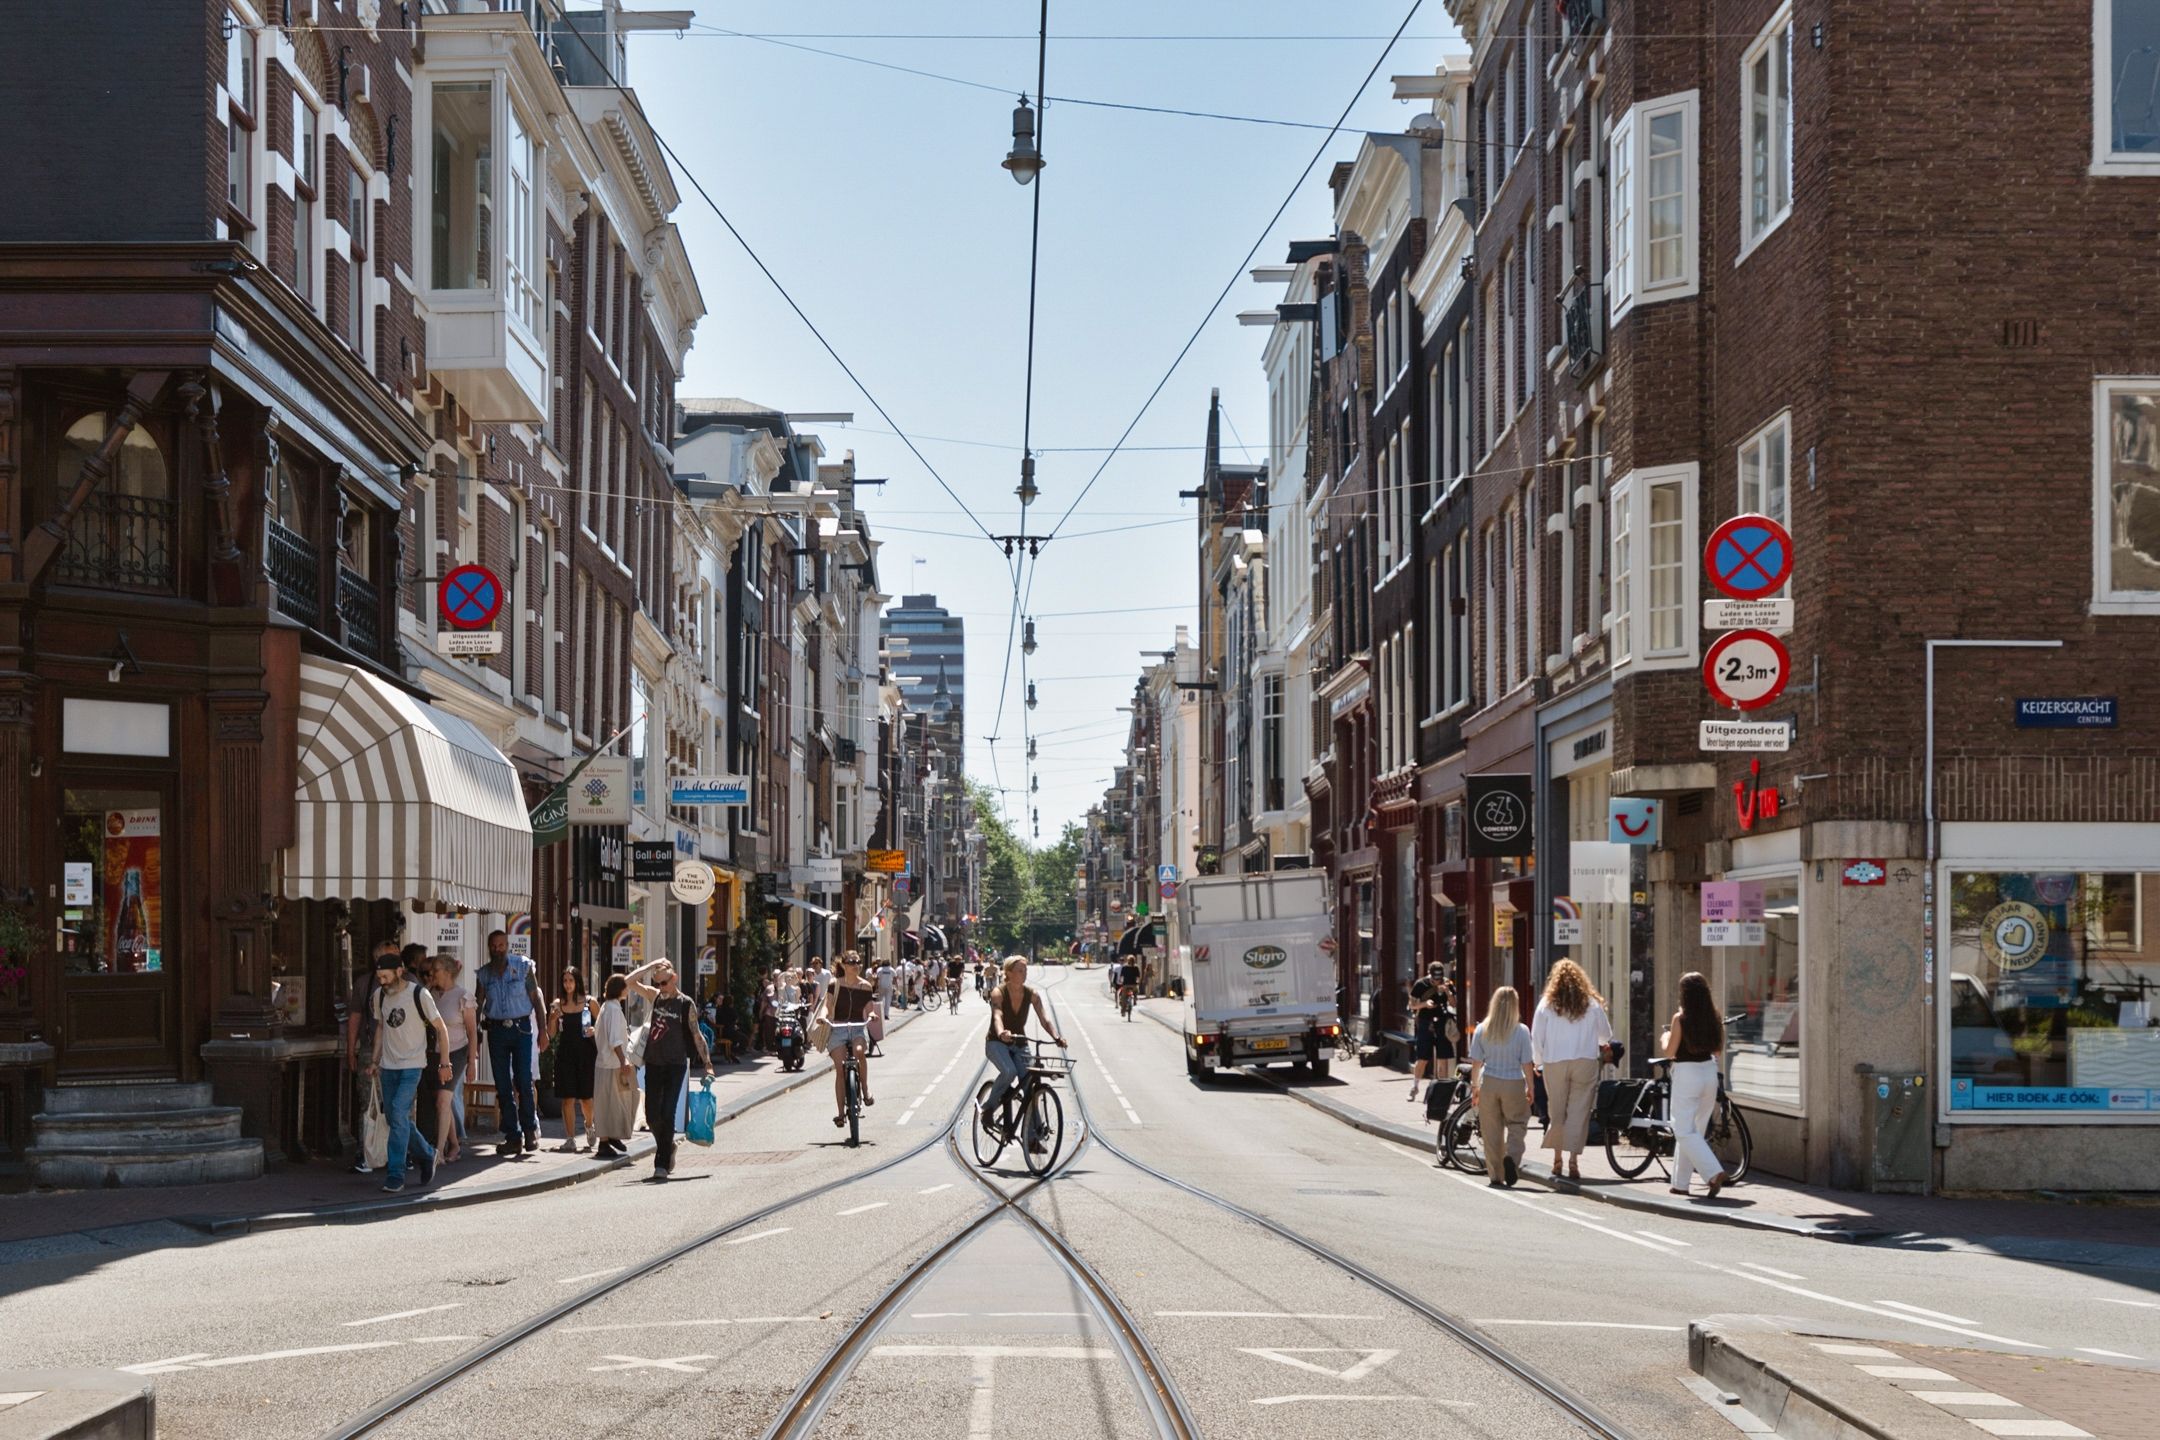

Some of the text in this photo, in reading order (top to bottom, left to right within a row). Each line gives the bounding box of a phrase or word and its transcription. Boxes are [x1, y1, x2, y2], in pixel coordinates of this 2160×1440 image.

[1724, 602, 1776, 610] Uitgezonderd
[2022, 701, 2111, 714] KEIZERSGRACHT
[2077, 716, 2112, 724] CENTRUM
[1706, 725, 1785, 736] Uitgezonderd
[1736, 738, 1762, 749] openbaar
[1764, 740, 1785, 748] vervoer
[674, 779, 745, 792] W. de Graaf
[130, 815, 158, 824] DRINK
[1482, 825, 1518, 833] CONCERTO
[1706, 900, 1734, 908] CELEBRATE
[1246, 951, 1285, 964] Sligro
[1986, 1092, 2014, 1104] HIER
[2017, 1092, 2050, 1104] BOEK
[2052, 1092, 2069, 1104] JE
